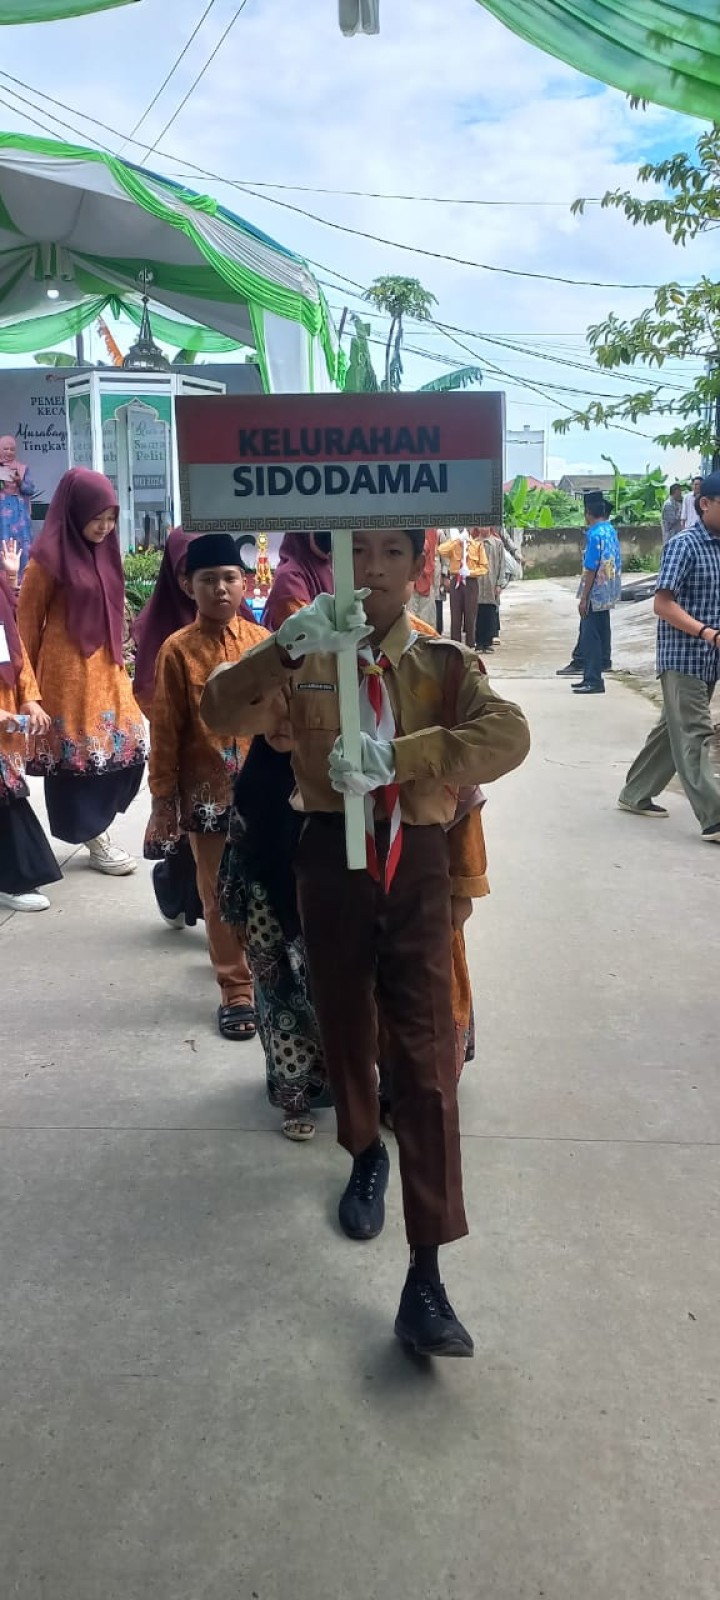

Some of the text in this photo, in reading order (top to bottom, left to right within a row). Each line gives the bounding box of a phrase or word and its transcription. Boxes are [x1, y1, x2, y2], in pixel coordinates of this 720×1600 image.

[23, 441, 67, 454] Tingkat
[238, 426, 441, 457] KELURAHAN
[233, 463, 449, 497] SIDODAMAI
